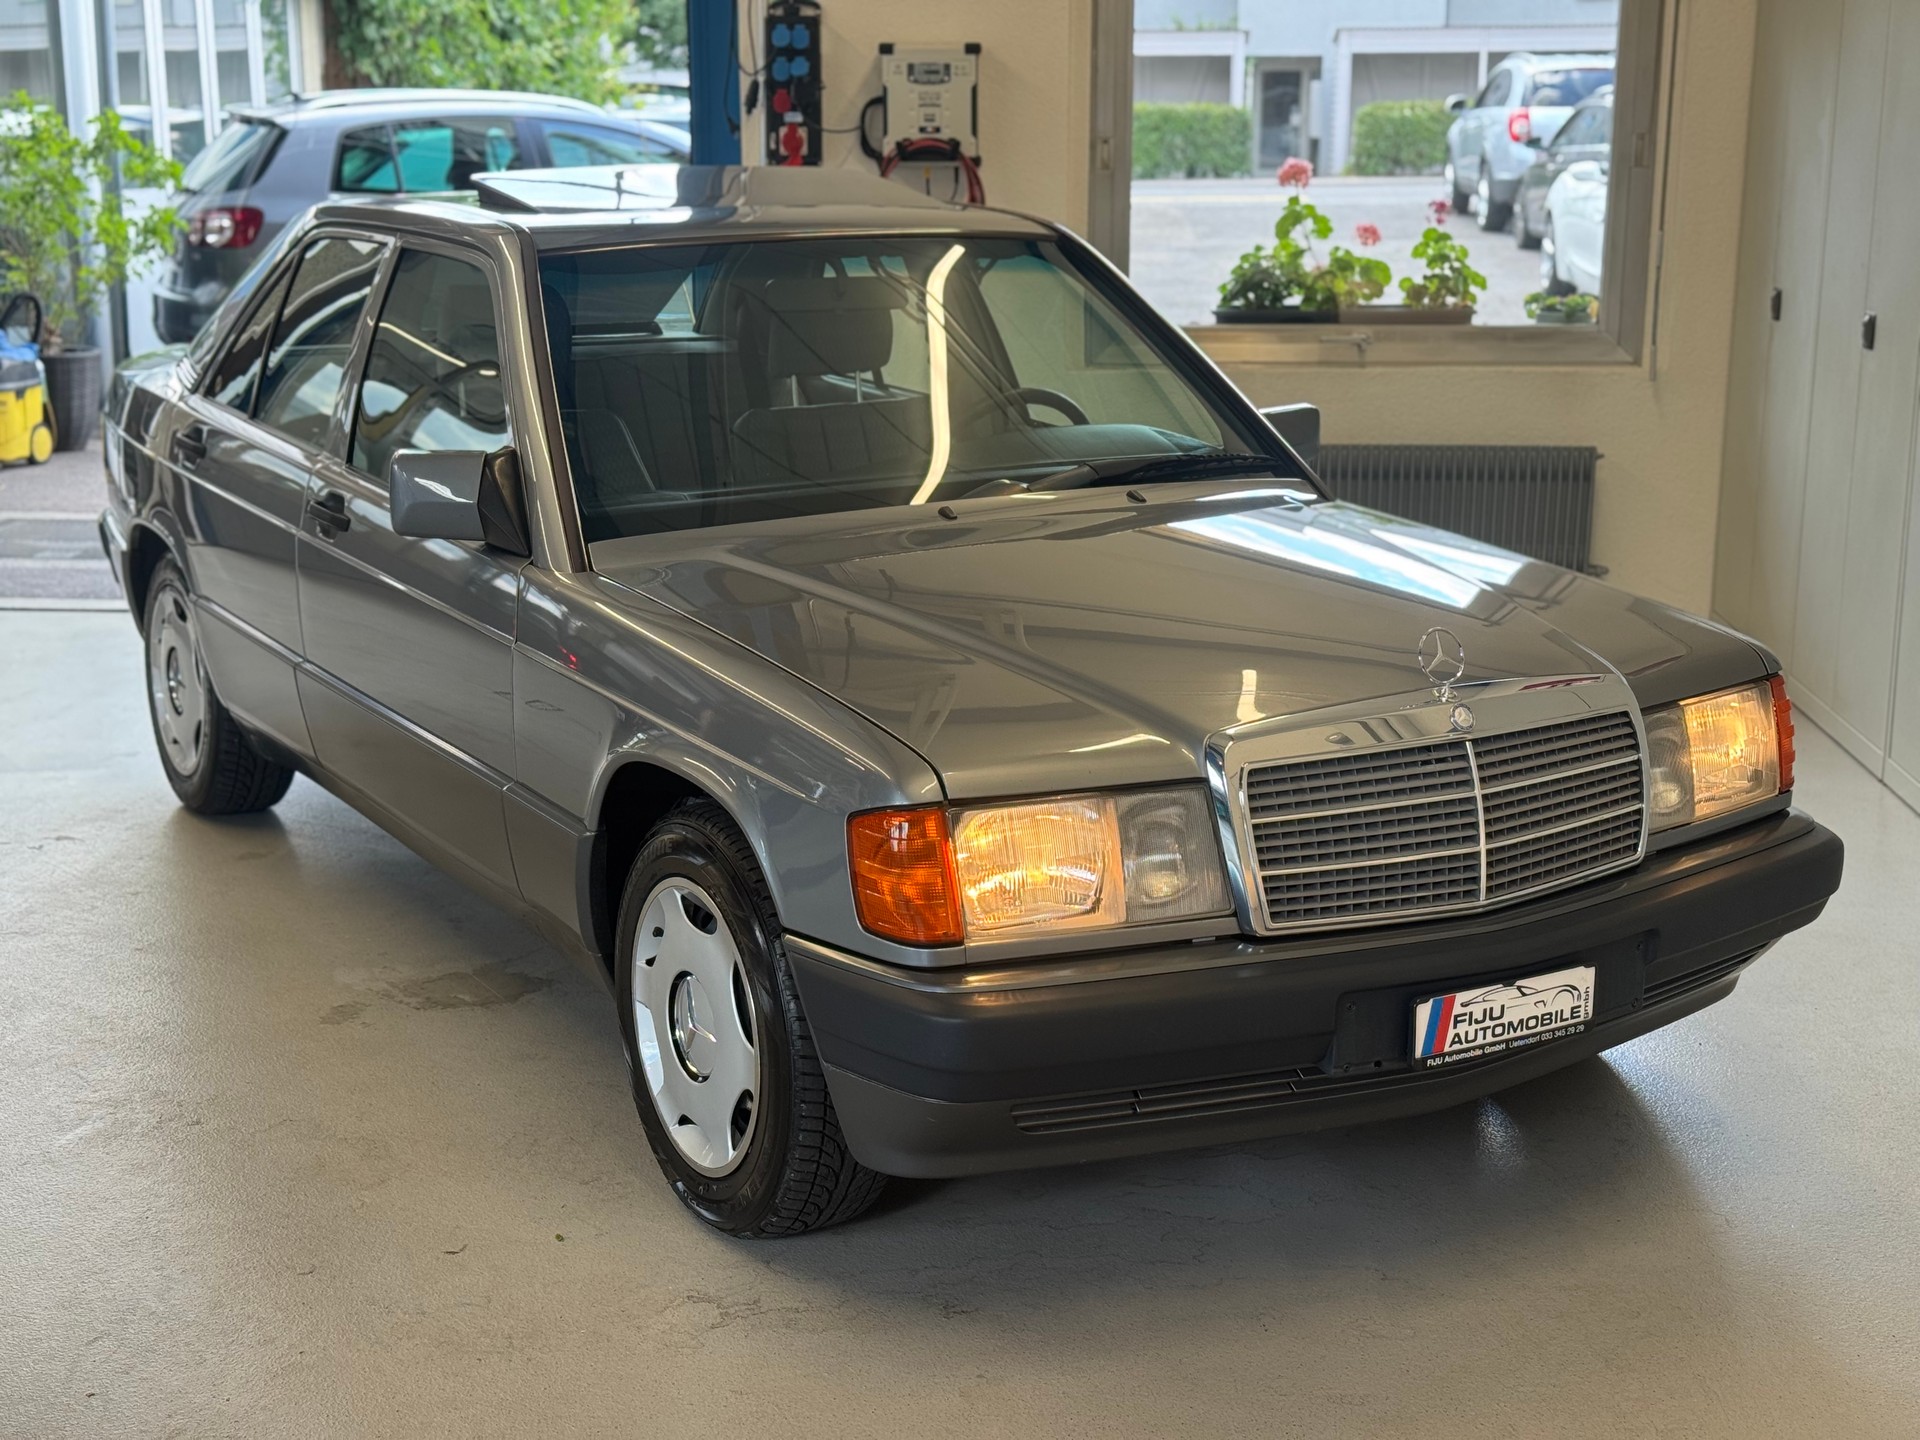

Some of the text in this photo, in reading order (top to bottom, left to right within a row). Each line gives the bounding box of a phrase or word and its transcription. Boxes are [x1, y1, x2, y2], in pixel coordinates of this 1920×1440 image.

[1449, 1004, 1582, 1048] AUTOMOBILE
[1453, 1004, 1505, 1029] FIJU
[1427, 1056, 1443, 1067] FIJU
[1444, 1048, 1483, 1063] Automobile
[1484, 1042, 1506, 1054] GmbH
[1541, 1031, 1553, 1041] 033
[1554, 1027, 1566, 1038] 345
[1567, 1026, 1576, 1036] 29
[1576, 1023, 1585, 1034] 29
